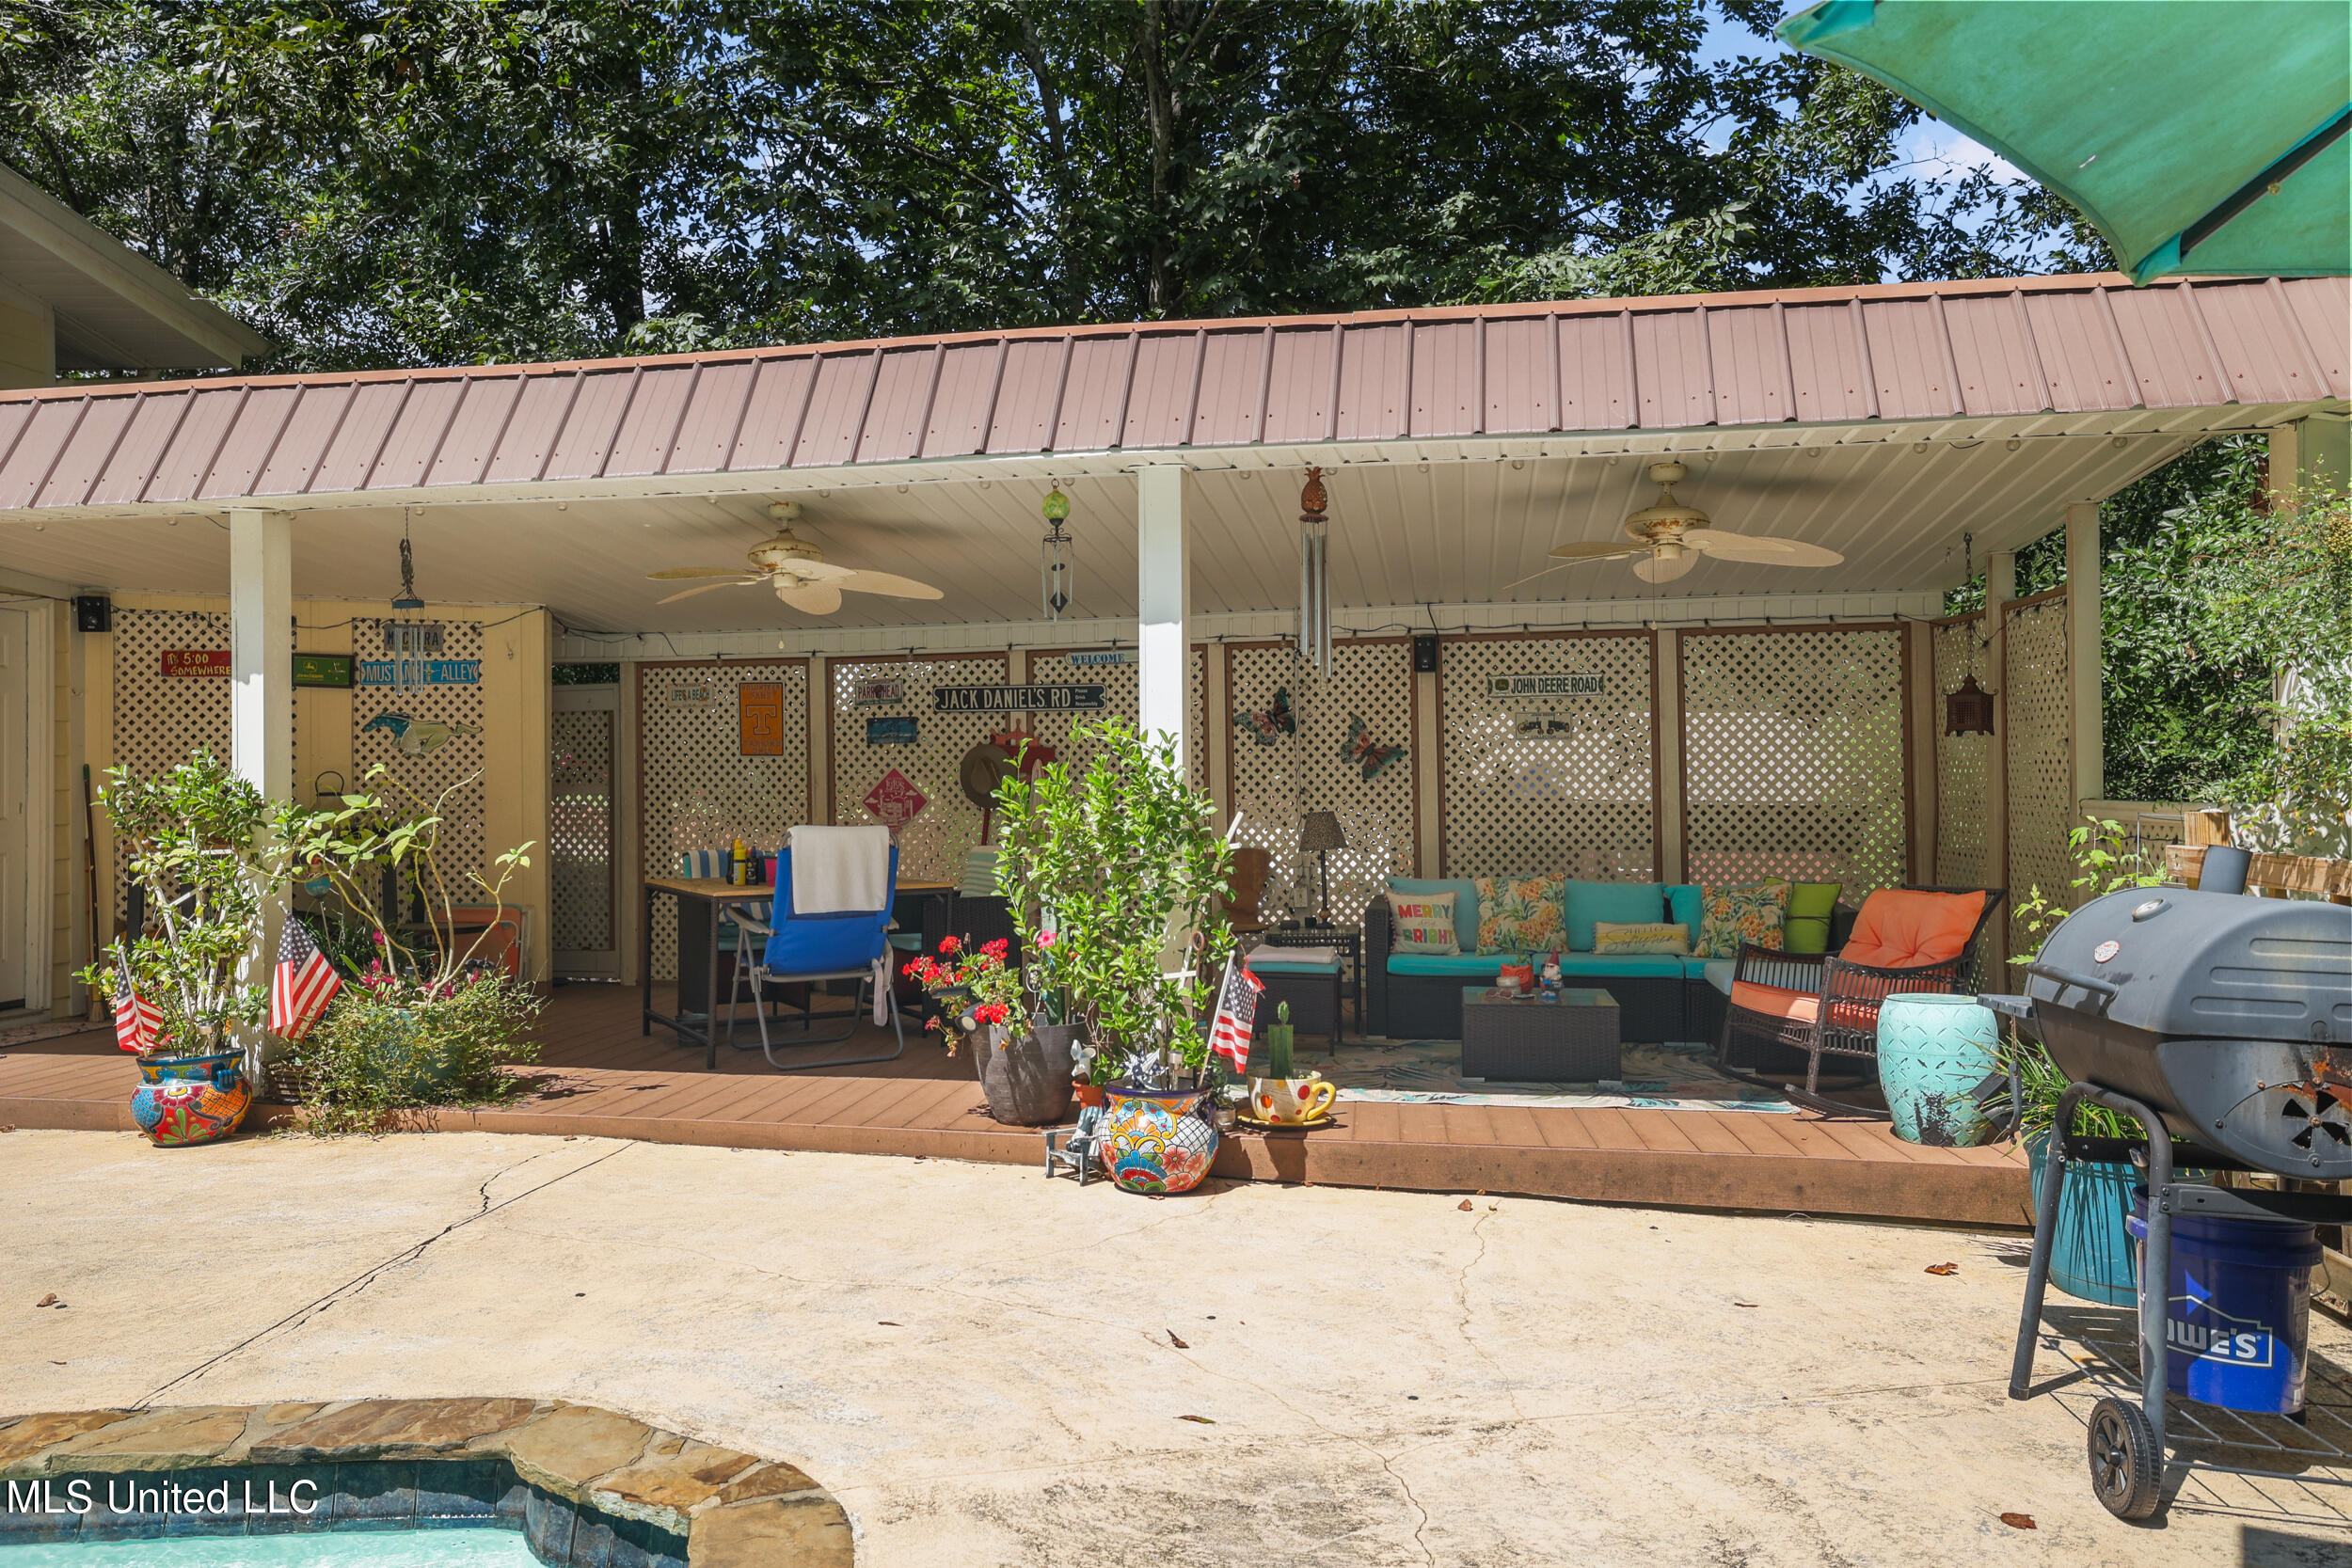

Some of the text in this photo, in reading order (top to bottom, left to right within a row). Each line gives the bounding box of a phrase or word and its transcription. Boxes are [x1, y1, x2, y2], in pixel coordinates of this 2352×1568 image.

[183, 653, 209, 664] 5:00
[1072, 653, 1125, 664] WELCOME
[170, 665, 231, 676] SOMEWHERE
[440, 663, 474, 681] ALLEY
[1511, 676, 1597, 694] JOHN DEERE ROAD
[941, 688, 1071, 708] JACK DANIEL'S RD
[746, 705, 777, 735] T
[1398, 904, 1450, 918] MERRY
[1403, 928, 1454, 944] BRIGHT
[2167, 1318, 2257, 1359] WE'S
